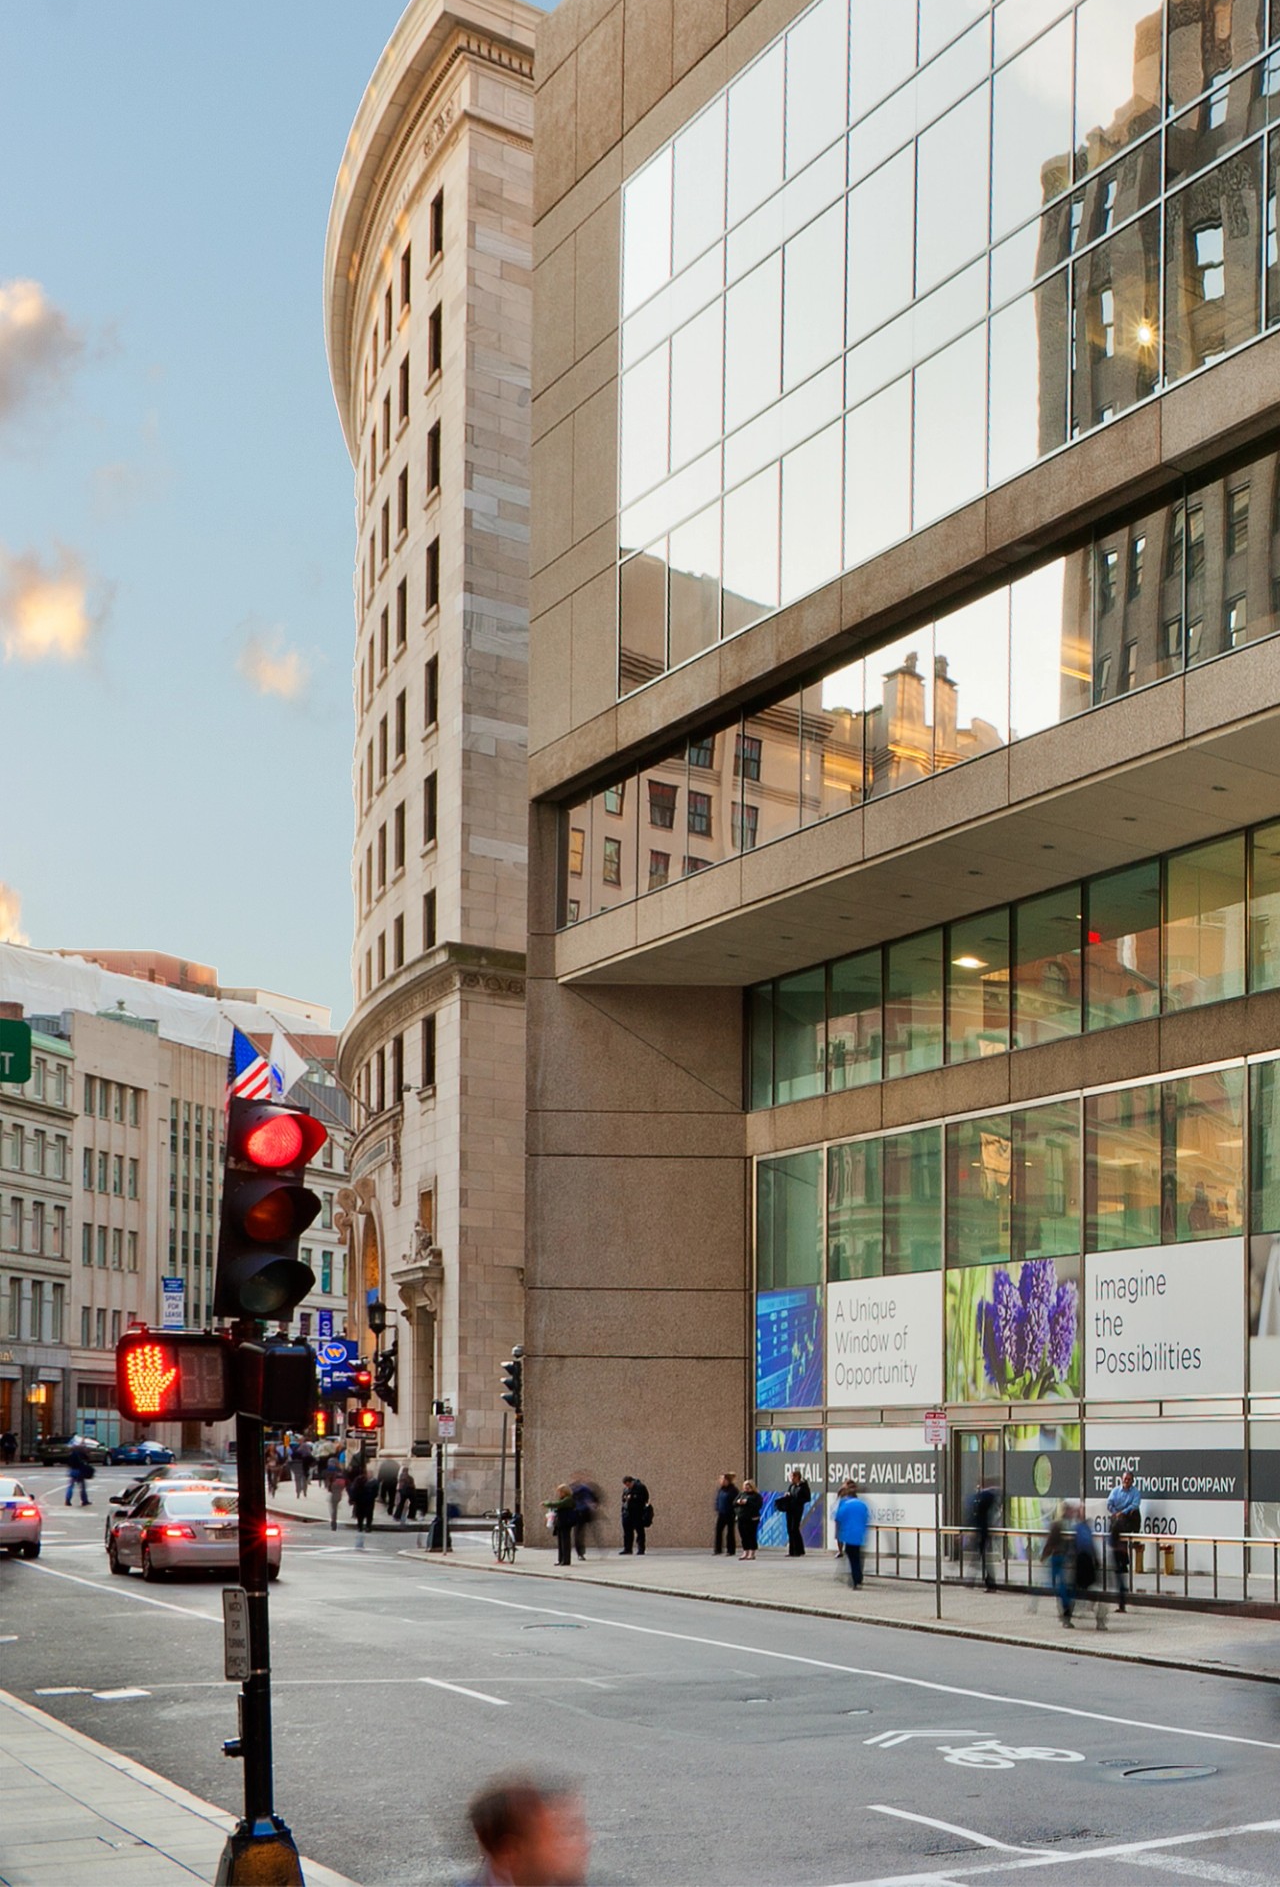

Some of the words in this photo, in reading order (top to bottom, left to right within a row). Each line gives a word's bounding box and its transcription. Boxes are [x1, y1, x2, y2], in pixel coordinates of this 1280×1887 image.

[1095, 1269, 1167, 1303] Imagine
[834, 1300, 845, 1323] A
[850, 1297, 897, 1324] Unique
[1095, 1309, 1123, 1337] the
[835, 1330, 890, 1354] Window
[894, 1324, 909, 1351] of
[1096, 1342, 1202, 1374] Possibilities
[835, 1360, 918, 1390] Opportunity
[828, 1463, 867, 1483] SPACE
[869, 1463, 936, 1484] AVAILABLE
[1093, 1456, 1141, 1472] CONTACT
[1093, 1475, 1113, 1491] THE
[1115, 1476, 1179, 1492] DTMOUTH
[1181, 1476, 1237, 1493] COMPANY
